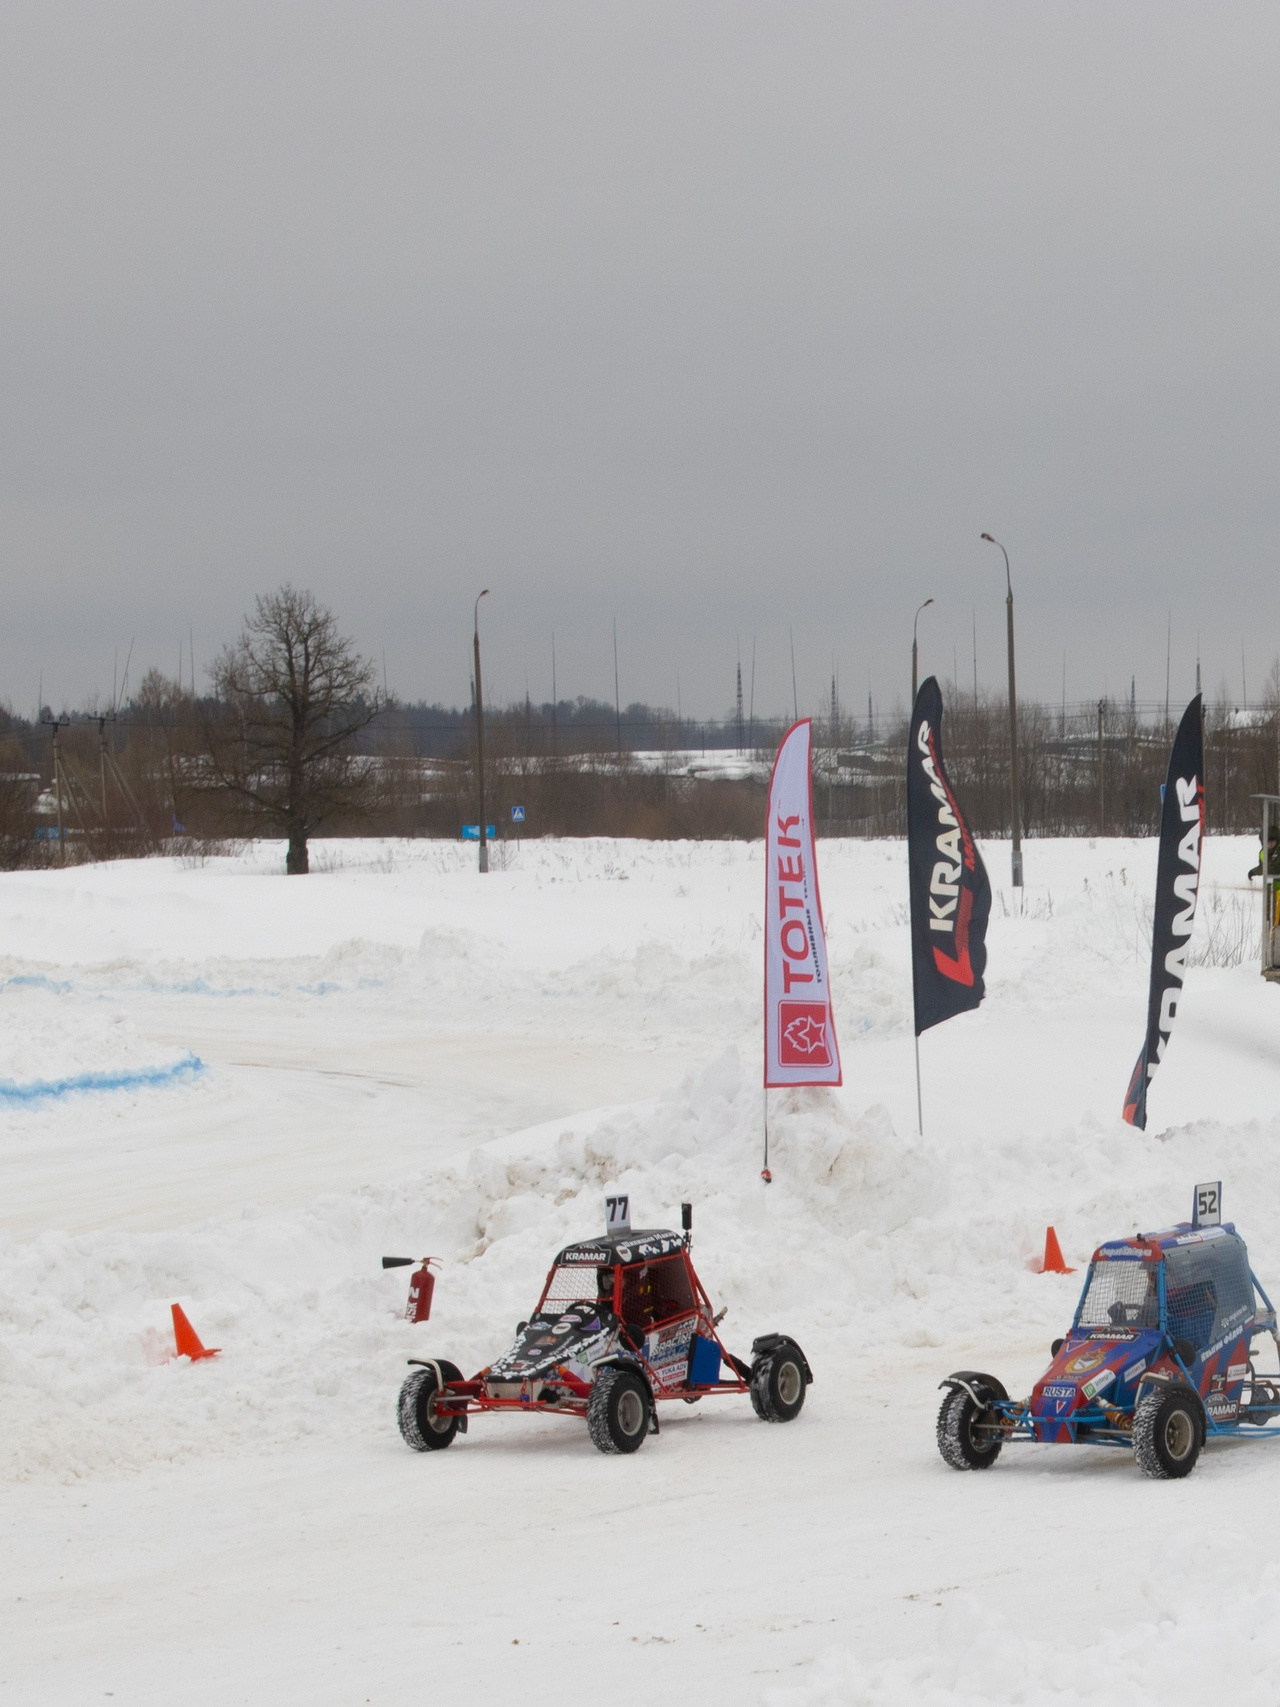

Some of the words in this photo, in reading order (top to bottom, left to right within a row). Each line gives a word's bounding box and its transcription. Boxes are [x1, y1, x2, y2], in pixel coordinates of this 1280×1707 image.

[806, 908, 822, 983] ТОПЛИВНЫЕ
[606, 1196, 629, 1222] 77
[1198, 1190, 1217, 1216] 52
[565, 1252, 607, 1261] KRAMAR
[1043, 1387, 1076, 1397] RUSTA
[1208, 1404, 1237, 1415] RAMAR
